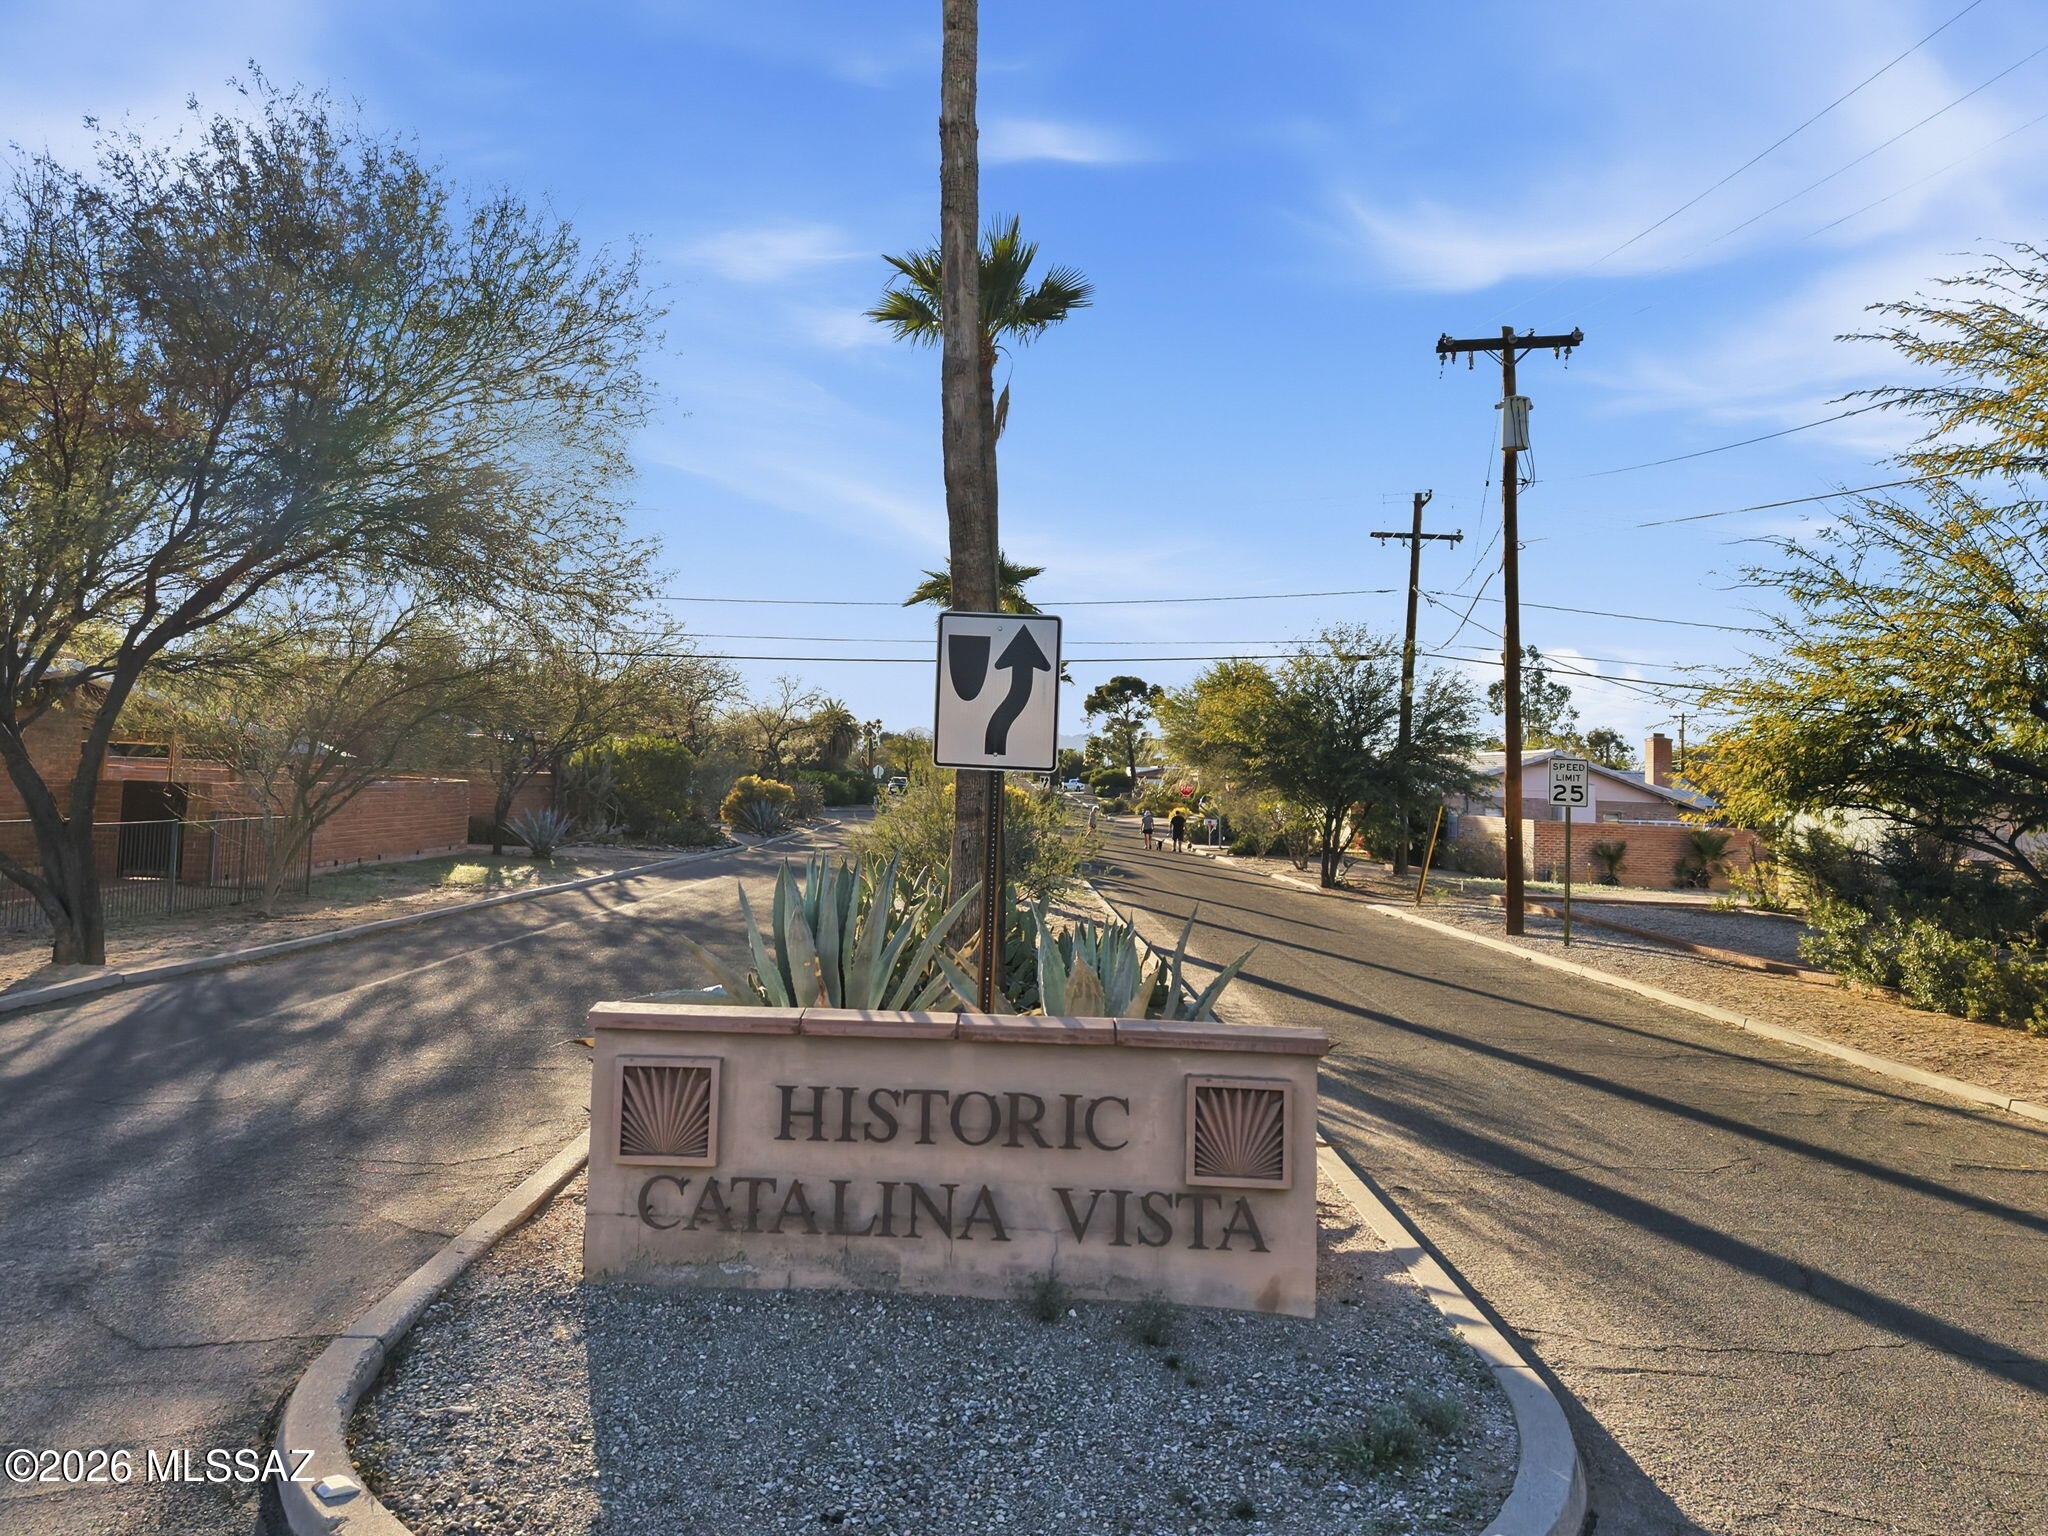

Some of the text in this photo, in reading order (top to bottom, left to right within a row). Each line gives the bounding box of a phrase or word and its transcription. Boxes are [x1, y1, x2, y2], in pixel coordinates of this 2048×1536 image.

[1553, 763, 1585, 771] SPEED
[1556, 774, 1581, 782] LIMIT
[1553, 785, 1584, 802] 25
[774, 1083, 1130, 1152] HISTORIC
[637, 1174, 1272, 1254] CATALINA VISTA
